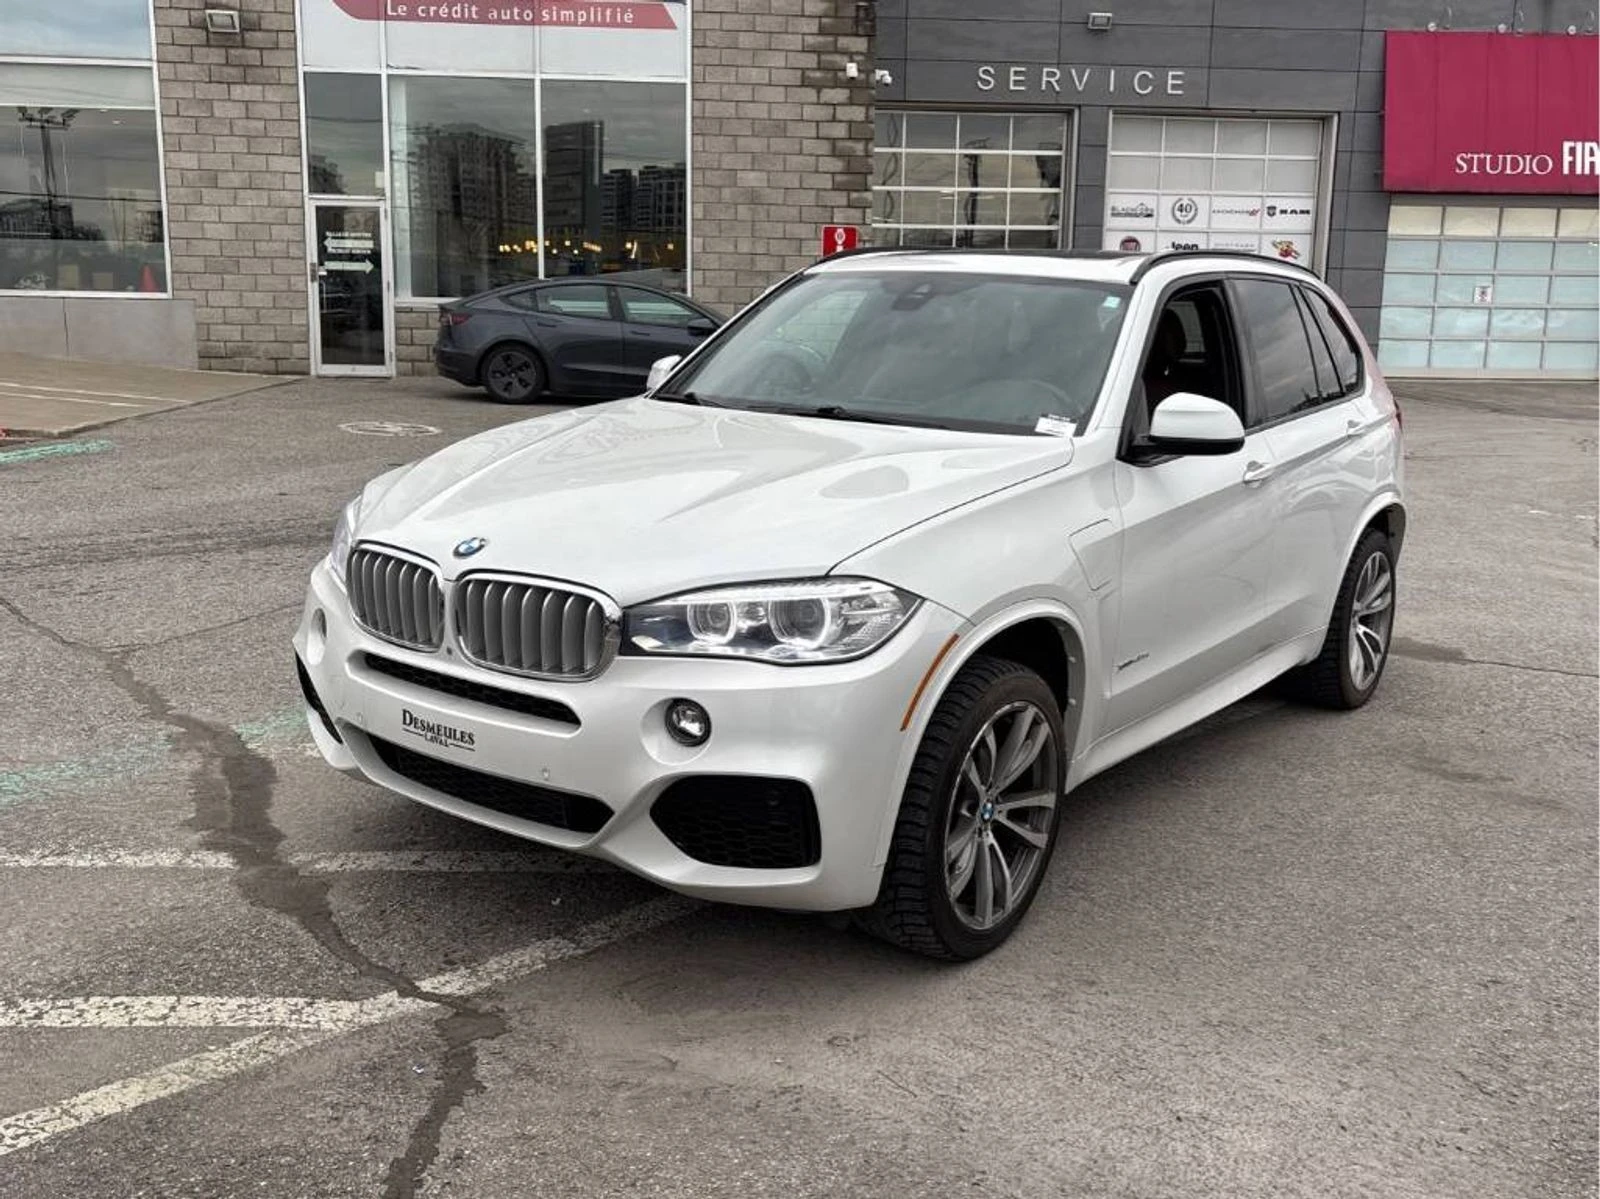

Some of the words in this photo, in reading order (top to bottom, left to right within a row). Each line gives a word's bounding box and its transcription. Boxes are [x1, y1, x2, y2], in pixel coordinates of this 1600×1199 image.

[386, 0, 407, 16] Le
[418, 3, 479, 19] crédit
[488, 7, 533, 21] auto
[541, 6, 634, 25] simplifié
[977, 66, 1185, 95] SERVICE
[1455, 153, 1553, 175] STUDIO
[1562, 141, 1599, 175] FIA
[1177, 203, 1193, 214] 40
